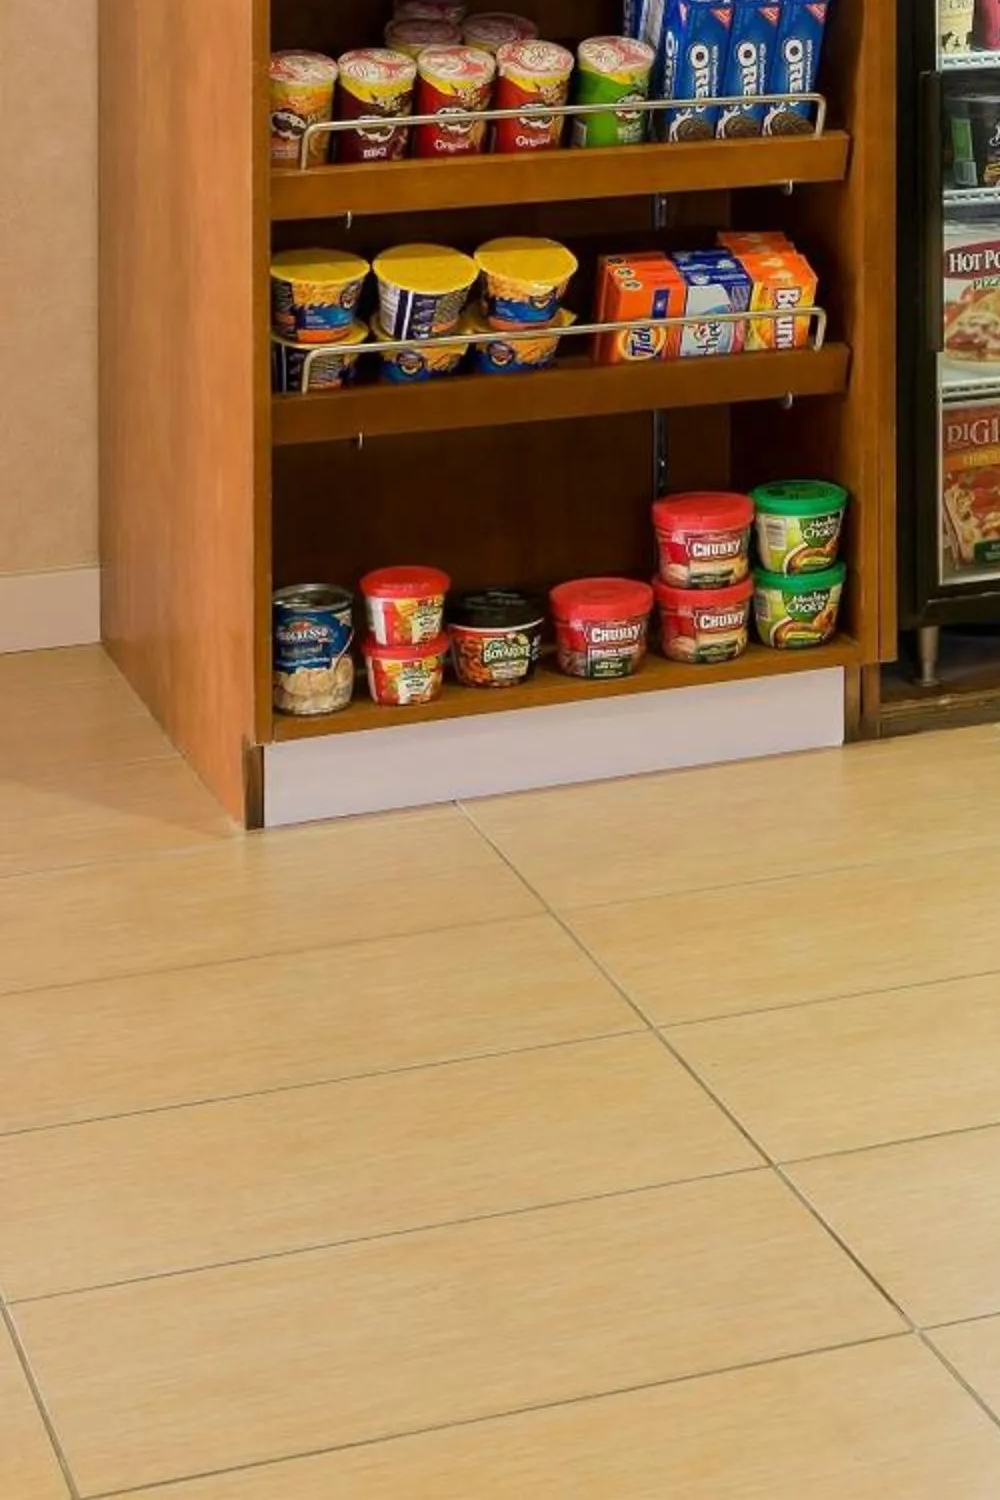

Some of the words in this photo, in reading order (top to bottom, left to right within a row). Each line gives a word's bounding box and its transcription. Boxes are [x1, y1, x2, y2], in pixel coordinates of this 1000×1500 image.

[950, 251, 984, 273] HOT
[692, 540, 740, 558] CHUNKY
[701, 611, 745, 629] CHUNKY
